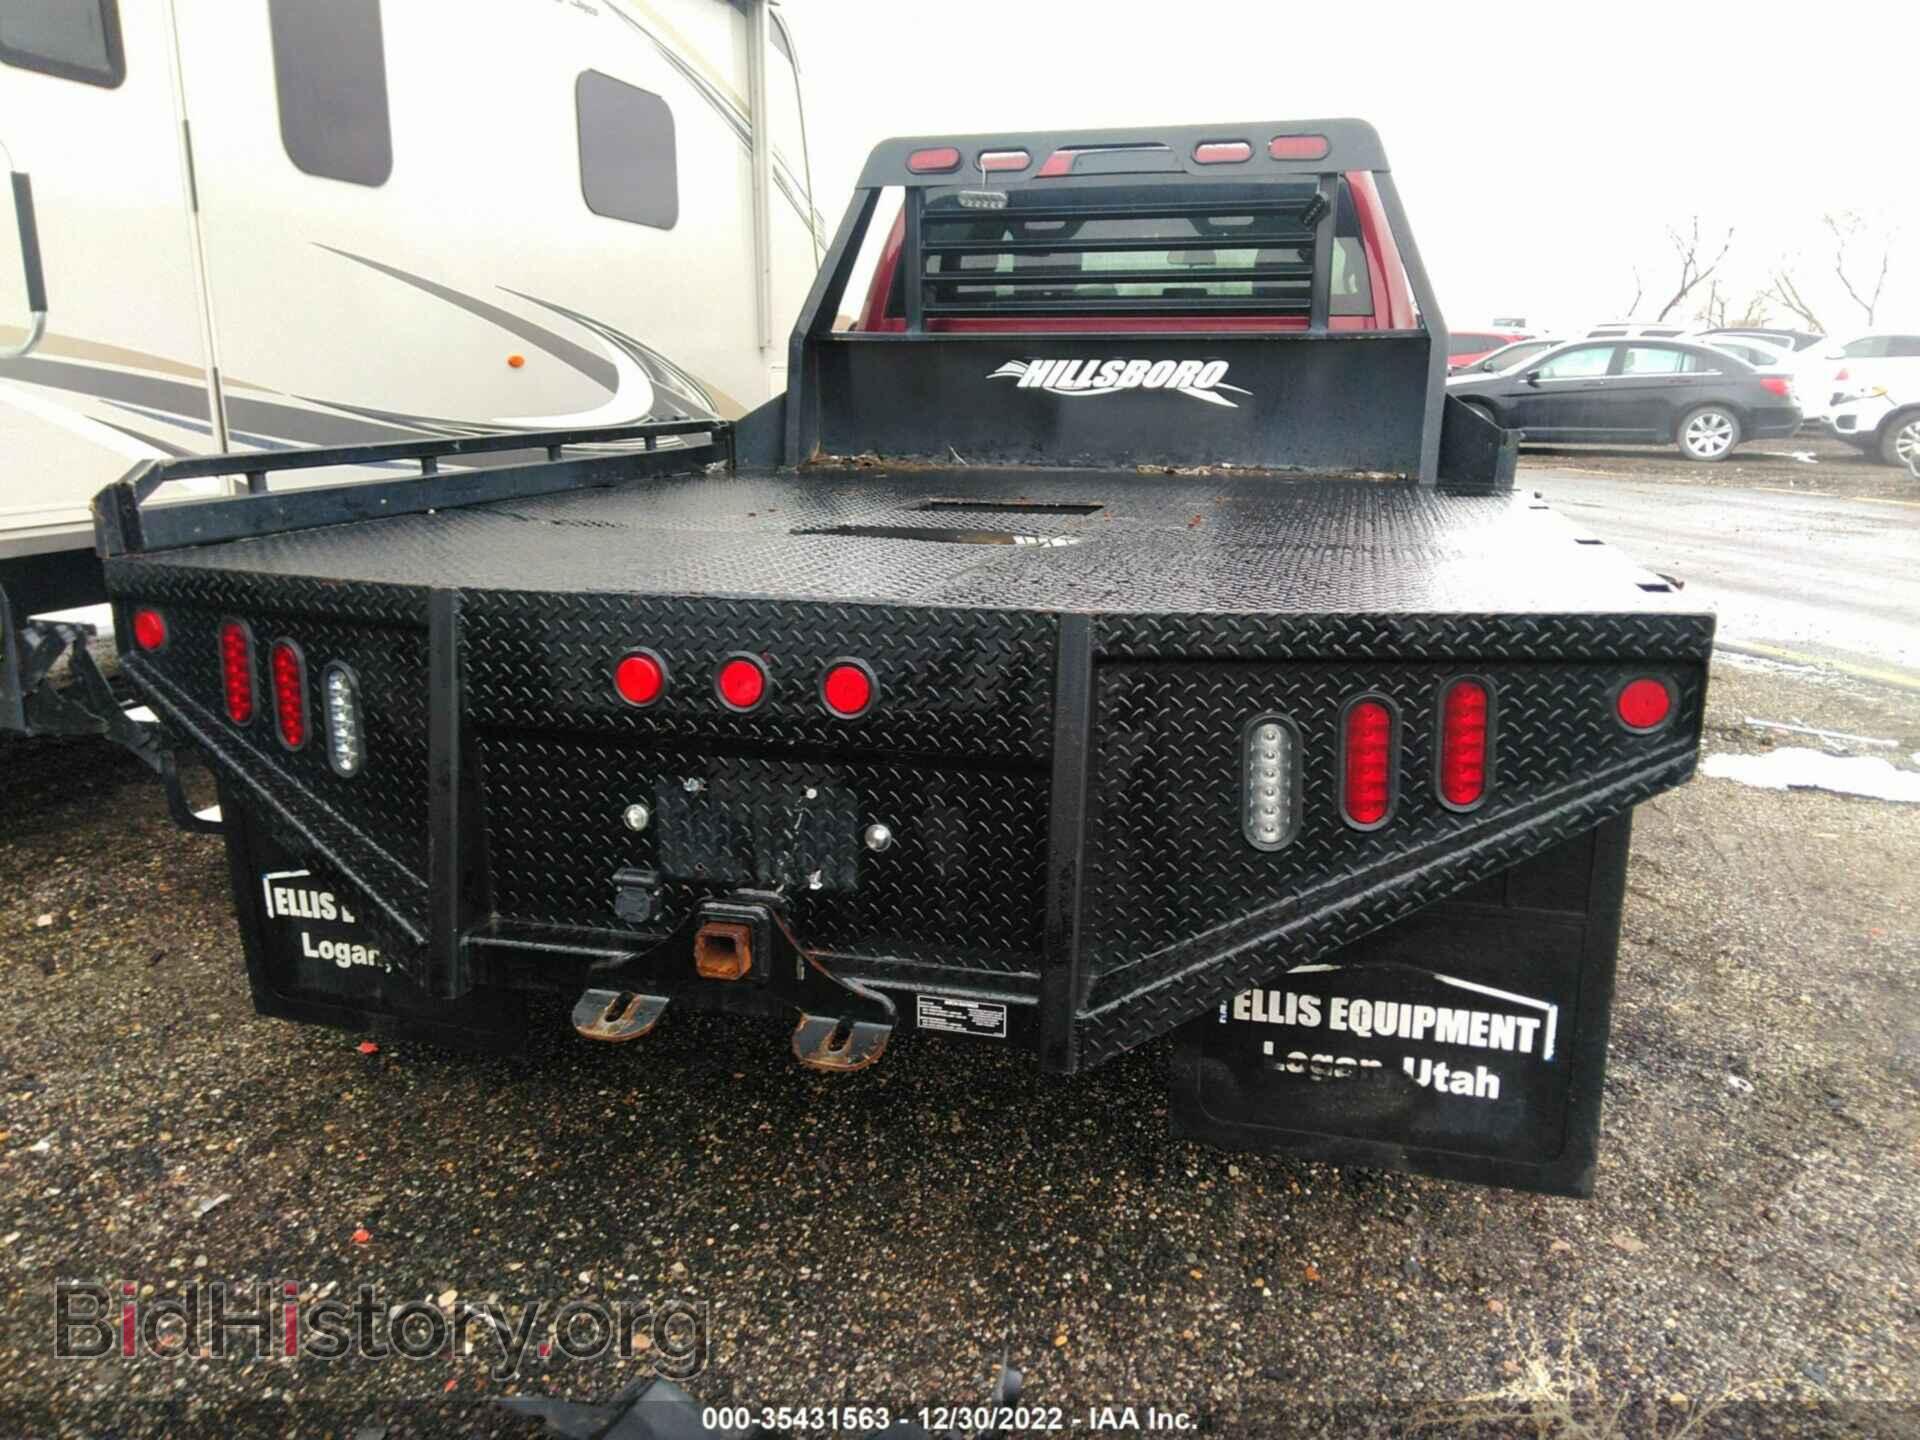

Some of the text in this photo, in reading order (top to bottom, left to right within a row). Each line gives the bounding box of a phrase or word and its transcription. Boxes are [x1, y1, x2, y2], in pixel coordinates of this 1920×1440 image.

[1016, 359, 1230, 389] HILLSBORO
[273, 886, 338, 921] ELLIS
[1233, 988, 1541, 1054] ELLIS EQUIPMENT
[1402, 1056, 1500, 1100] Utah
